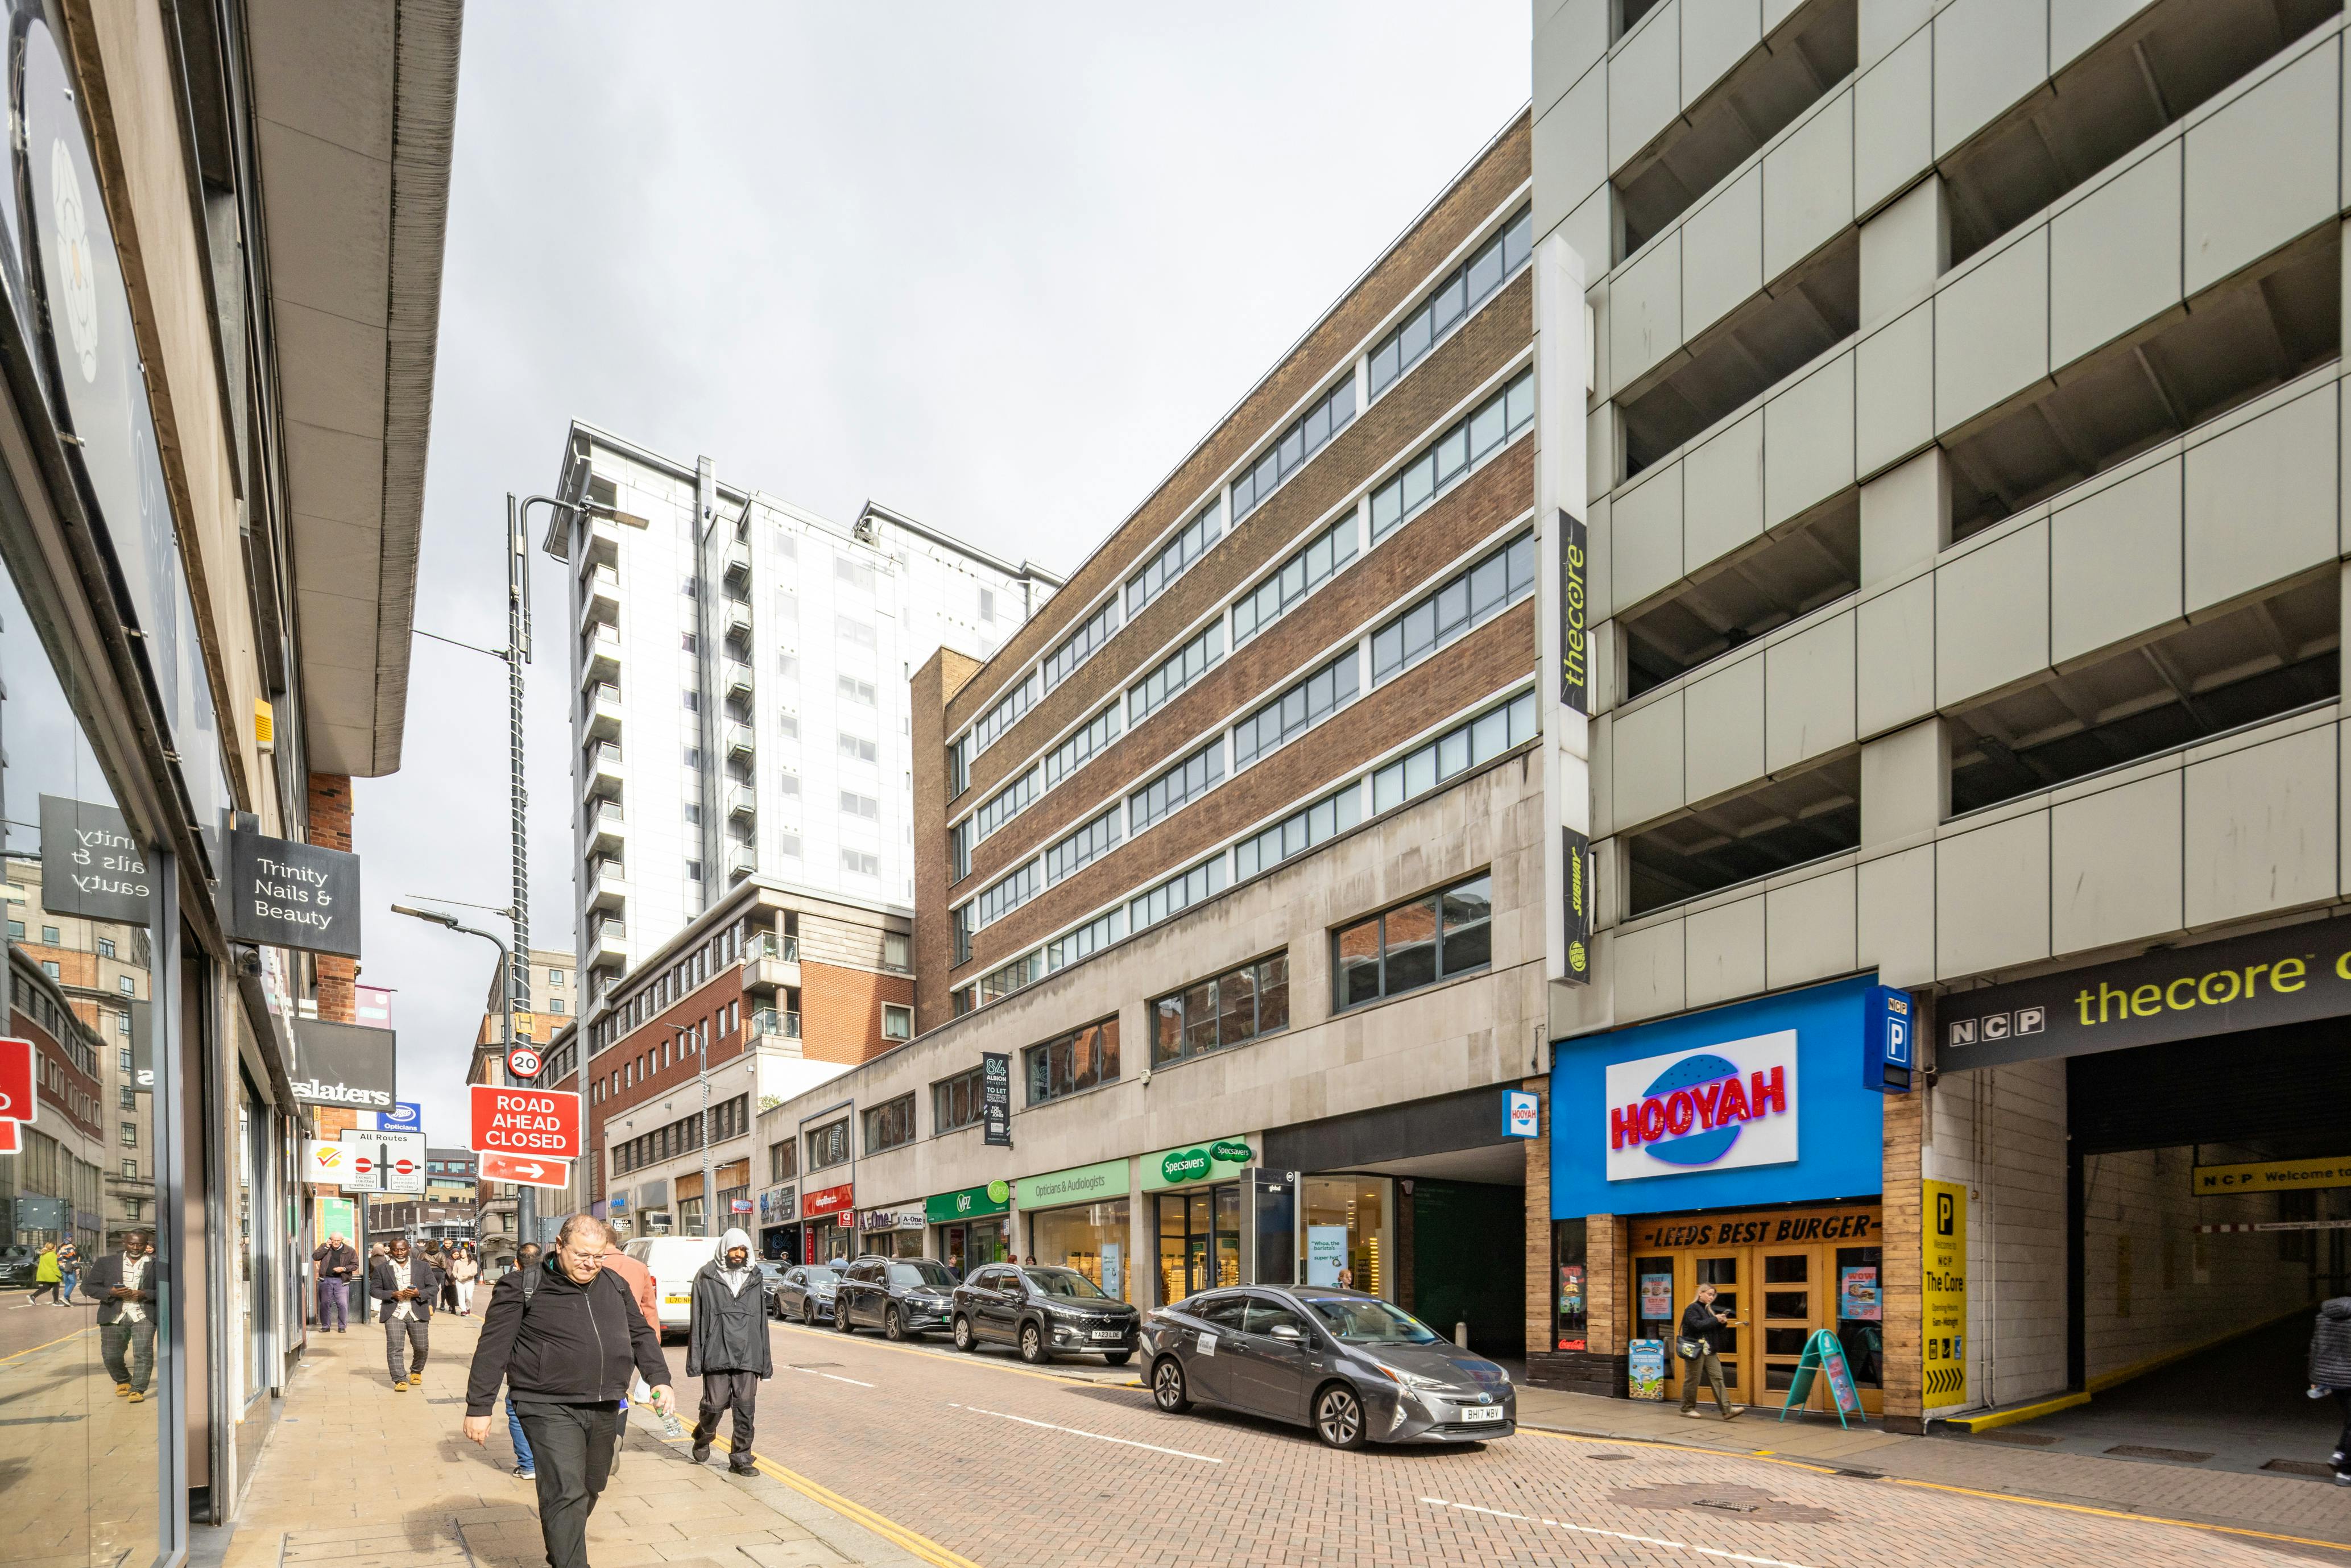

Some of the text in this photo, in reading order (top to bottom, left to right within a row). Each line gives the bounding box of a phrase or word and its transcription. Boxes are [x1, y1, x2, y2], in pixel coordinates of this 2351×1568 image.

[1564, 544, 1584, 686] thecore
[257, 858, 328, 887] Trinity
[1572, 846, 1582, 917] SUBWAY
[255, 879, 333, 905] Nails &
[255, 900, 332, 930] Beauty
[1571, 946, 1584, 955] BURGER
[1571, 953, 1586, 962] KING
[1889, 998, 1907, 1015] NCP
[1952, 1010, 2042, 1045] NCP
[2074, 958, 2306, 1026] thecore
[518, 1014, 533, 1031] H
[1891, 1023, 1903, 1055] P
[514, 1056, 537, 1069] 20
[986, 1058, 1006, 1076] 84
[299, 1078, 391, 1106] slaters
[497, 1095, 554, 1113] ROAD
[1611, 1065, 1786, 1149] HOOYAH
[492, 1113, 560, 1131] AHEAD
[1512, 1109, 1536, 1119] HOOYAH
[486, 1130, 566, 1149] CLOSED
[1212, 1146, 1249, 1156] Specsavers
[1165, 1158, 1205, 1174] Specsavers
[2204, 1173, 2253, 1186] NCP
[2265, 1168, 2334, 1182] Welcome
[992, 1185, 1007, 1195] VPZ
[1036, 1175, 1105, 1198] Opticians & Audiologists
[958, 1195, 971, 1210] VPZ
[1940, 1197, 1951, 1232] P
[1717, 1221, 1770, 1244] BEST
[1938, 1255, 1952, 1267] NCP
[1927, 1271, 1963, 1292] The Core
[1932, 1303, 1947, 1314] Opening
[1468, 1408, 1499, 1419] BH17 MBV
